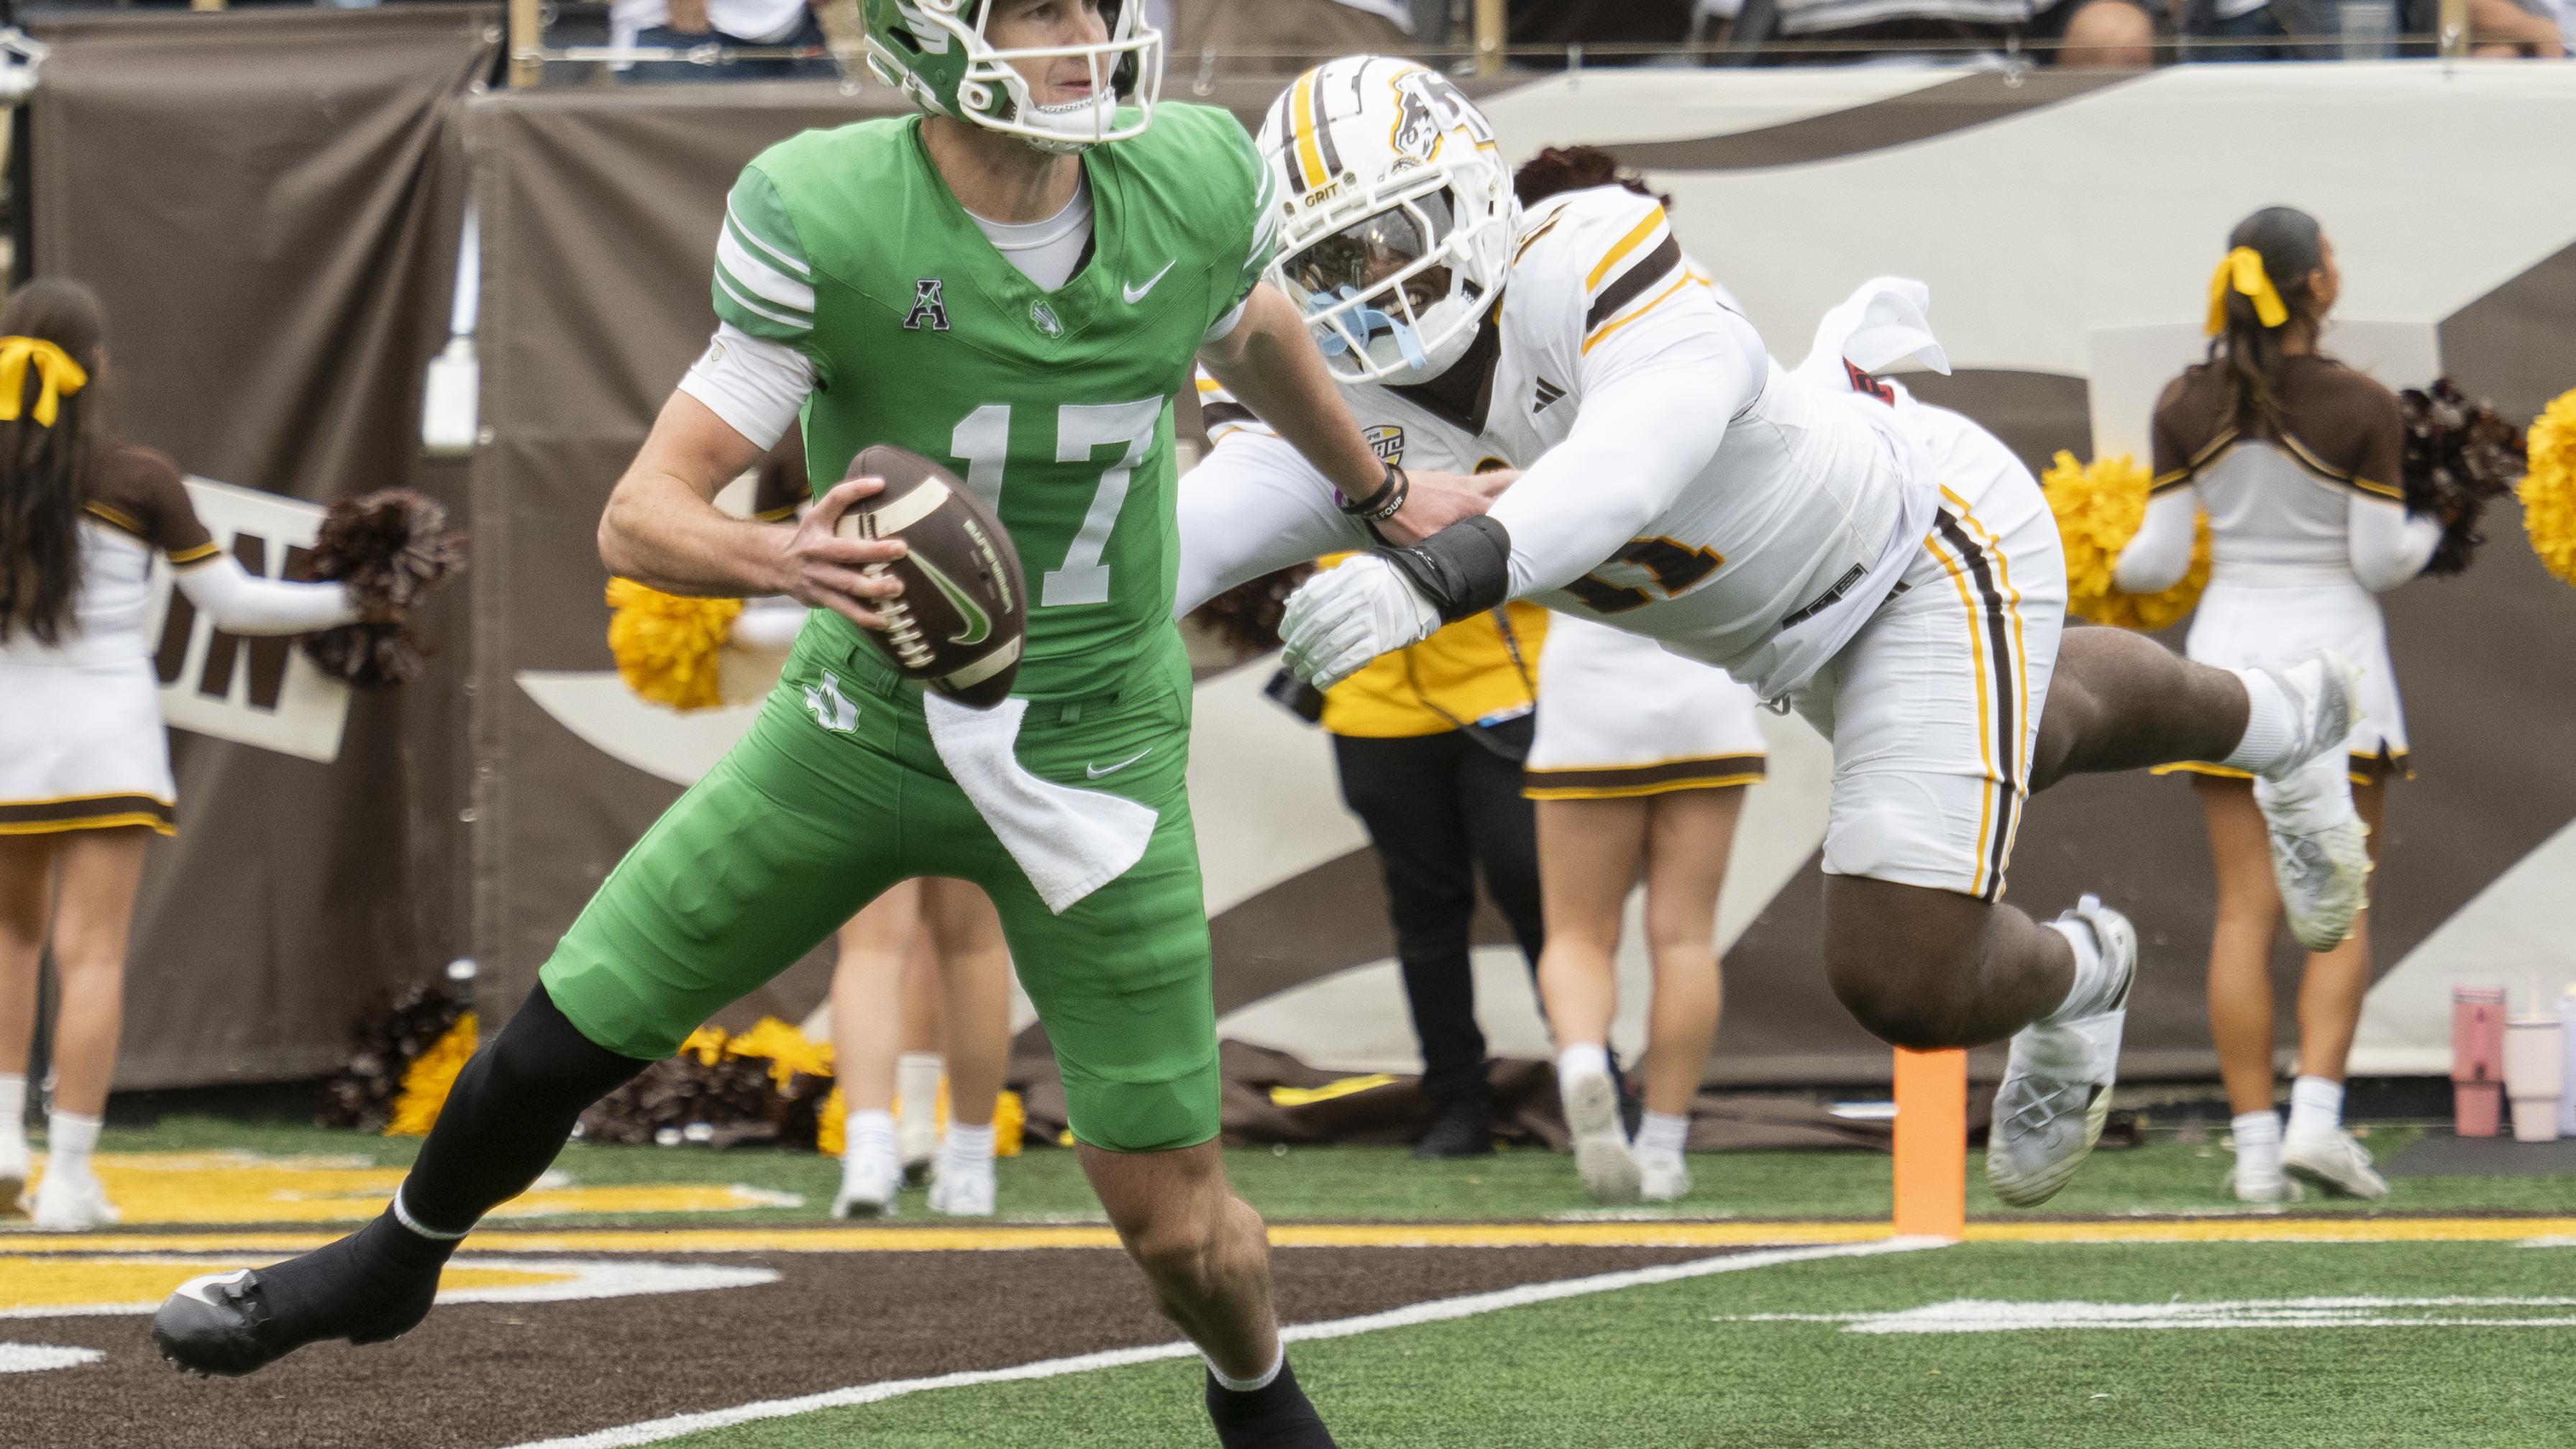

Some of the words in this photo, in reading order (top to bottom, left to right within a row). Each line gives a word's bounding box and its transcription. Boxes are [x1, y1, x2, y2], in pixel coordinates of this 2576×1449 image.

[1305, 183, 1338, 208] GRIT
[950, 394, 1164, 607] 17
[1379, 495, 1403, 518] FOUR
